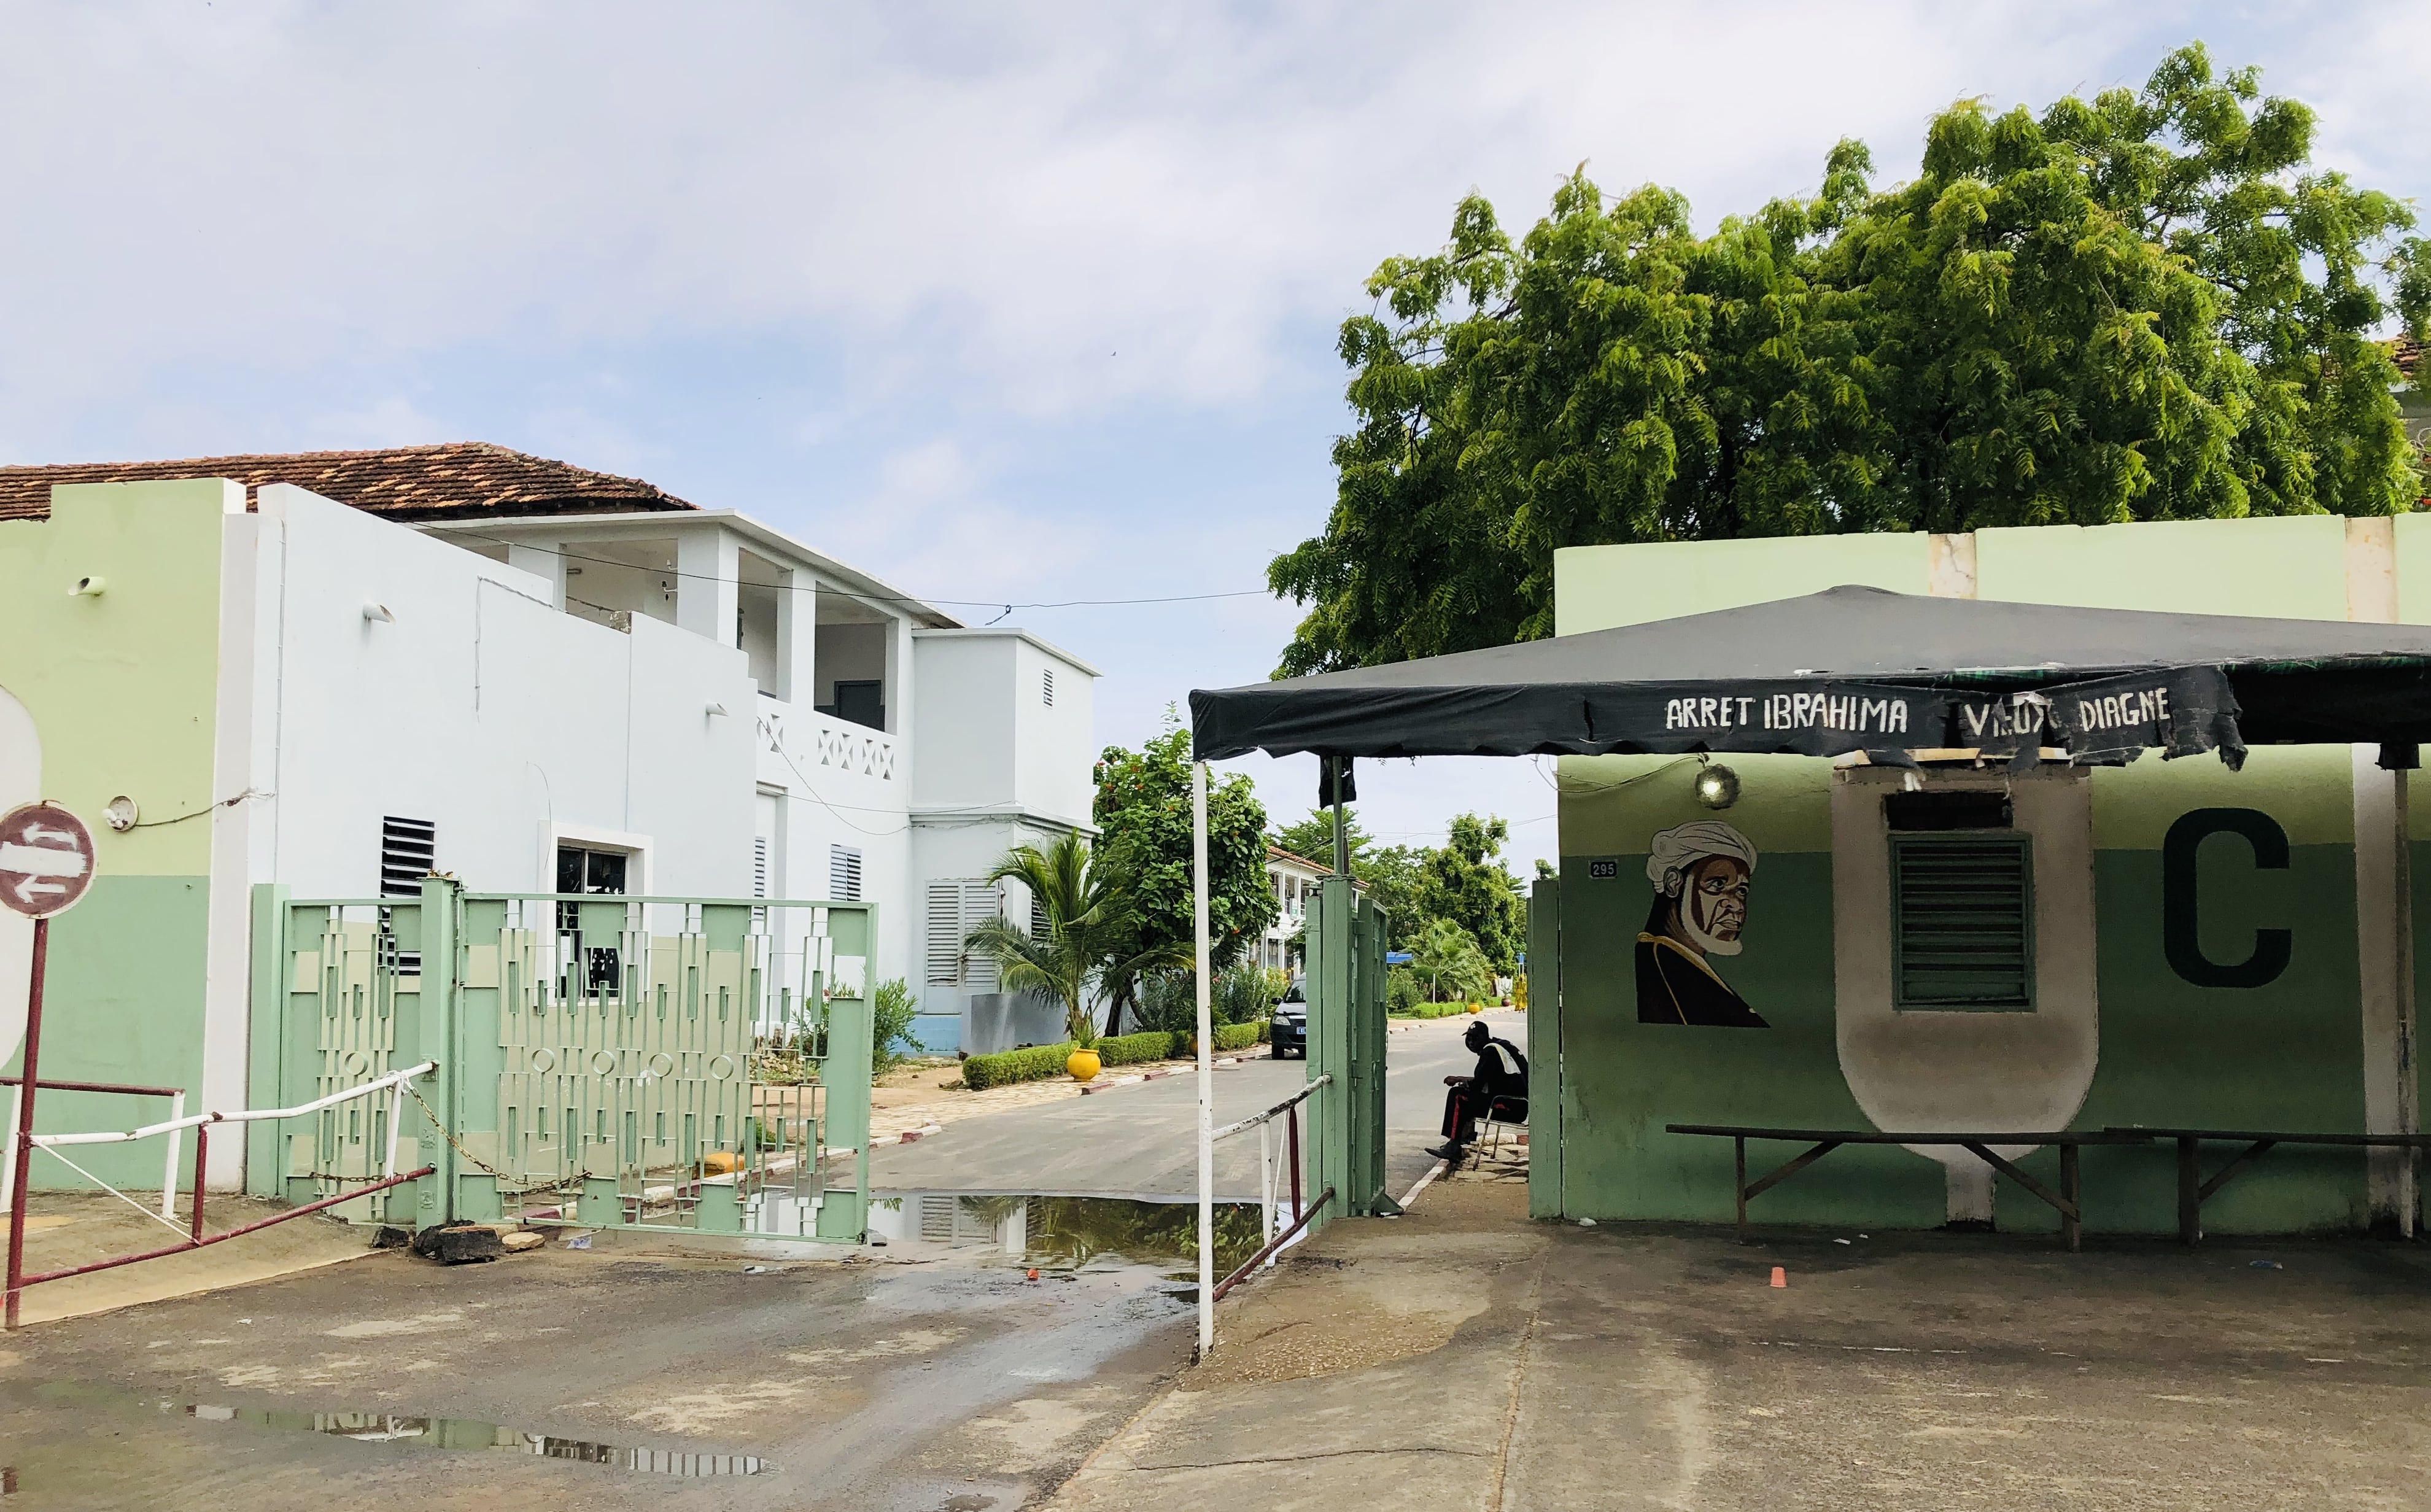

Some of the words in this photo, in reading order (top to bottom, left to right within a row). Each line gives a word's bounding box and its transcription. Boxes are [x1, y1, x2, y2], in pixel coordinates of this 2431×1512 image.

[1666, 697, 1756, 730] ARRET
[1764, 692, 1907, 734] IBRAHIMA
[2079, 688, 2170, 732] DIAGNE
[1593, 863, 1615, 875] 295
[2163, 808, 2292, 988] C
